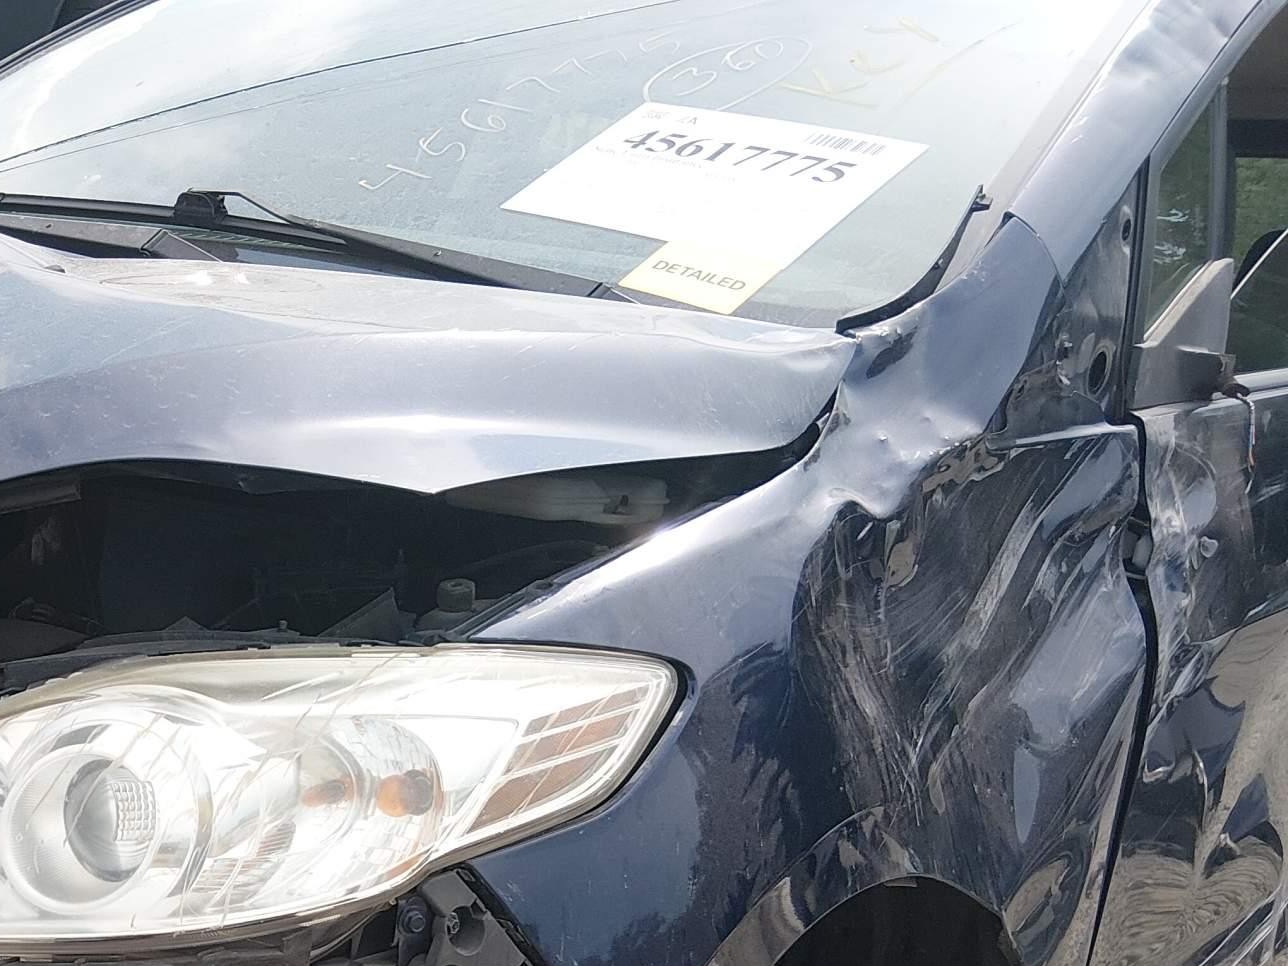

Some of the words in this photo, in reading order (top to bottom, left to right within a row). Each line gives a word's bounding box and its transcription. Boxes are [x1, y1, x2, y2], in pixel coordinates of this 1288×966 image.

[671, 38, 785, 97] 360
[358, 31, 681, 191] 45617775
[623, 130, 857, 183] 45617775
[651, 259, 748, 293] DETAILED
